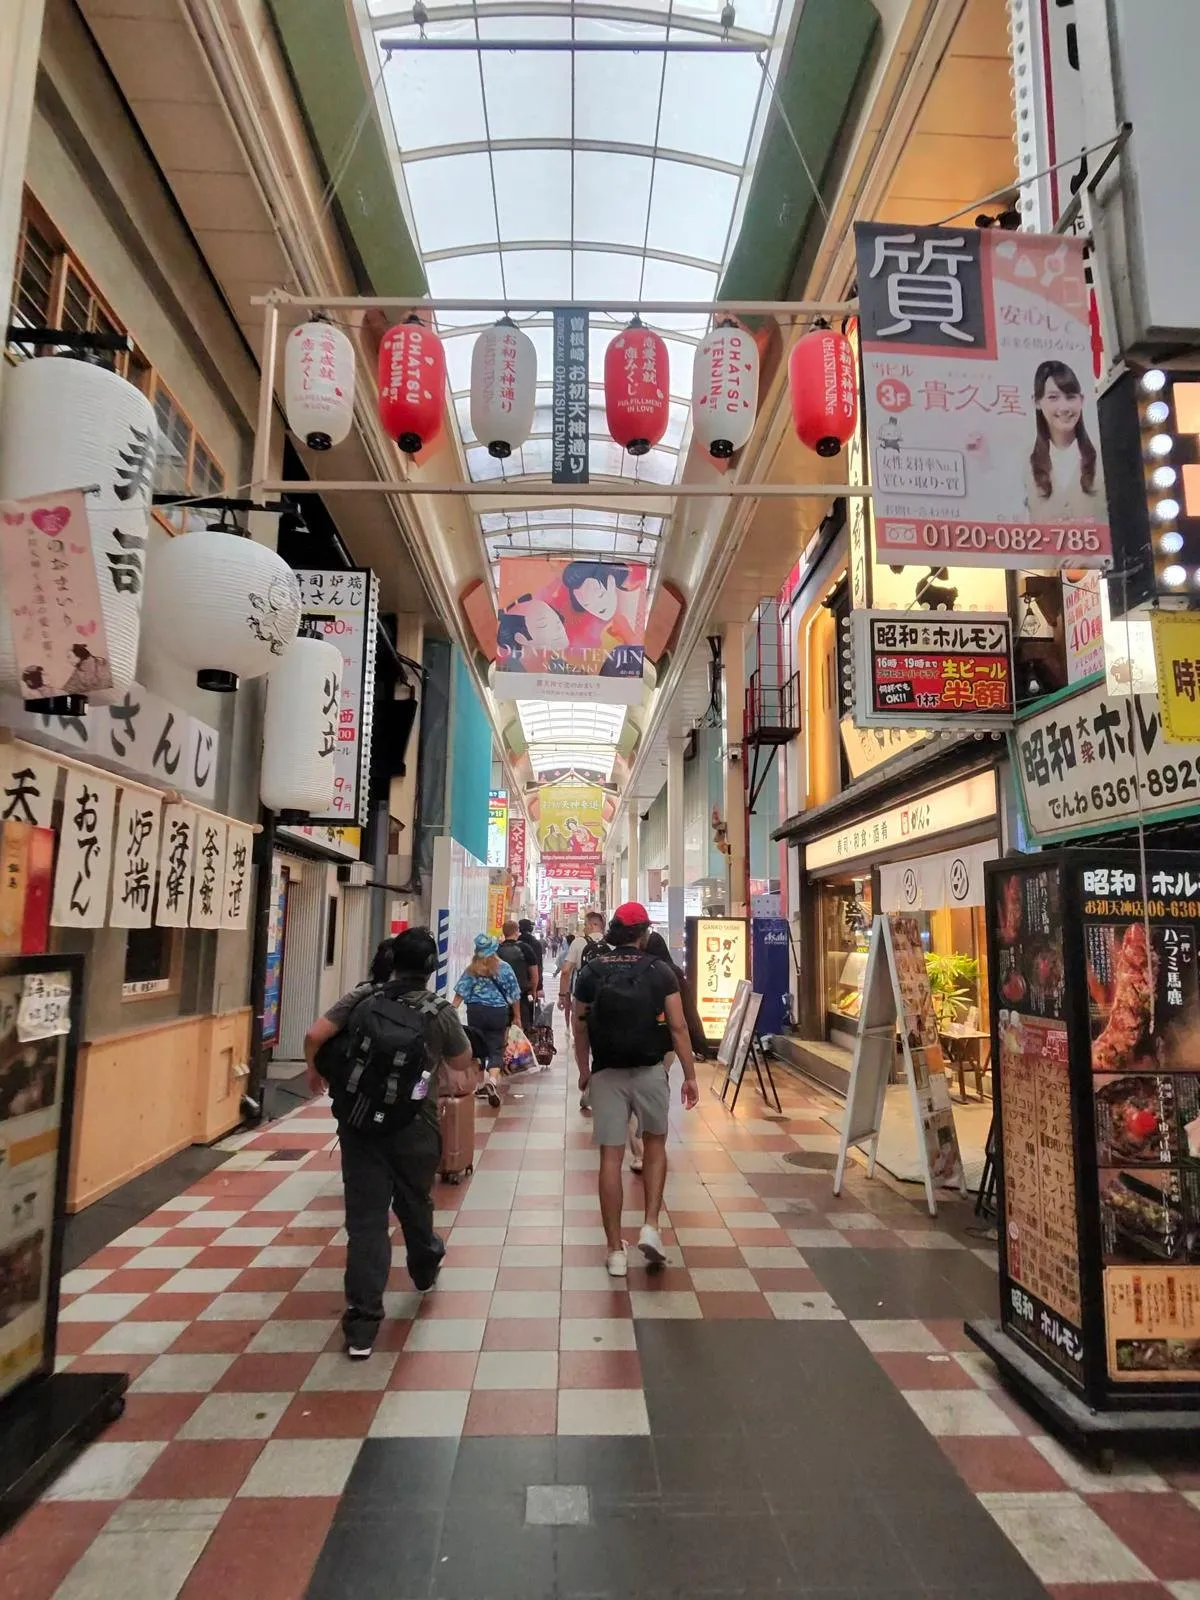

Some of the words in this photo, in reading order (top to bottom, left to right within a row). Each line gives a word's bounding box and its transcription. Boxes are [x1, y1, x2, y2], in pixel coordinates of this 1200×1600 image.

[869, 233, 975, 342] 質
[406, 331, 422, 405] OHATSU
[499, 334, 517, 414] お初天神通り
[711, 337, 725, 398] TENJIN
[727, 337, 742, 414] OHATSU
[918, 379, 1027, 416] 貴久屋
[554, 365, 566, 461] OHATSUTENJIN
[568, 364, 586, 474] お初天神通り
[922, 523, 1101, 551] 0120-082-785
[301, 590, 363, 607] さんじ
[578, 647, 645, 668] TENJIN
[941, 658, 1007, 679] 生ビール
[1172, 658, 1200, 703] 時
[915, 693, 940, 708] 1杯
[941, 680, 1006, 708] 半額
[1021, 693, 1163, 788] 昭和大衆ホル
[2, 767, 41, 826] 天
[1048, 791, 1088, 819] でんわ
[1090, 755, 1200, 811] 6361-892
[70, 784, 102, 918] おでん
[547, 869, 579, 877] カラオケ
[1083, 868, 1136, 896] 昭和
[1151, 870, 1200, 897] ホル
[721, 936, 739, 978] がんこ
[1163, 929, 1184, 1007] ハラミ馬鹿
[1011, 1287, 1034, 1322] 昭和
[1040, 1309, 1085, 1362] ホルモン
